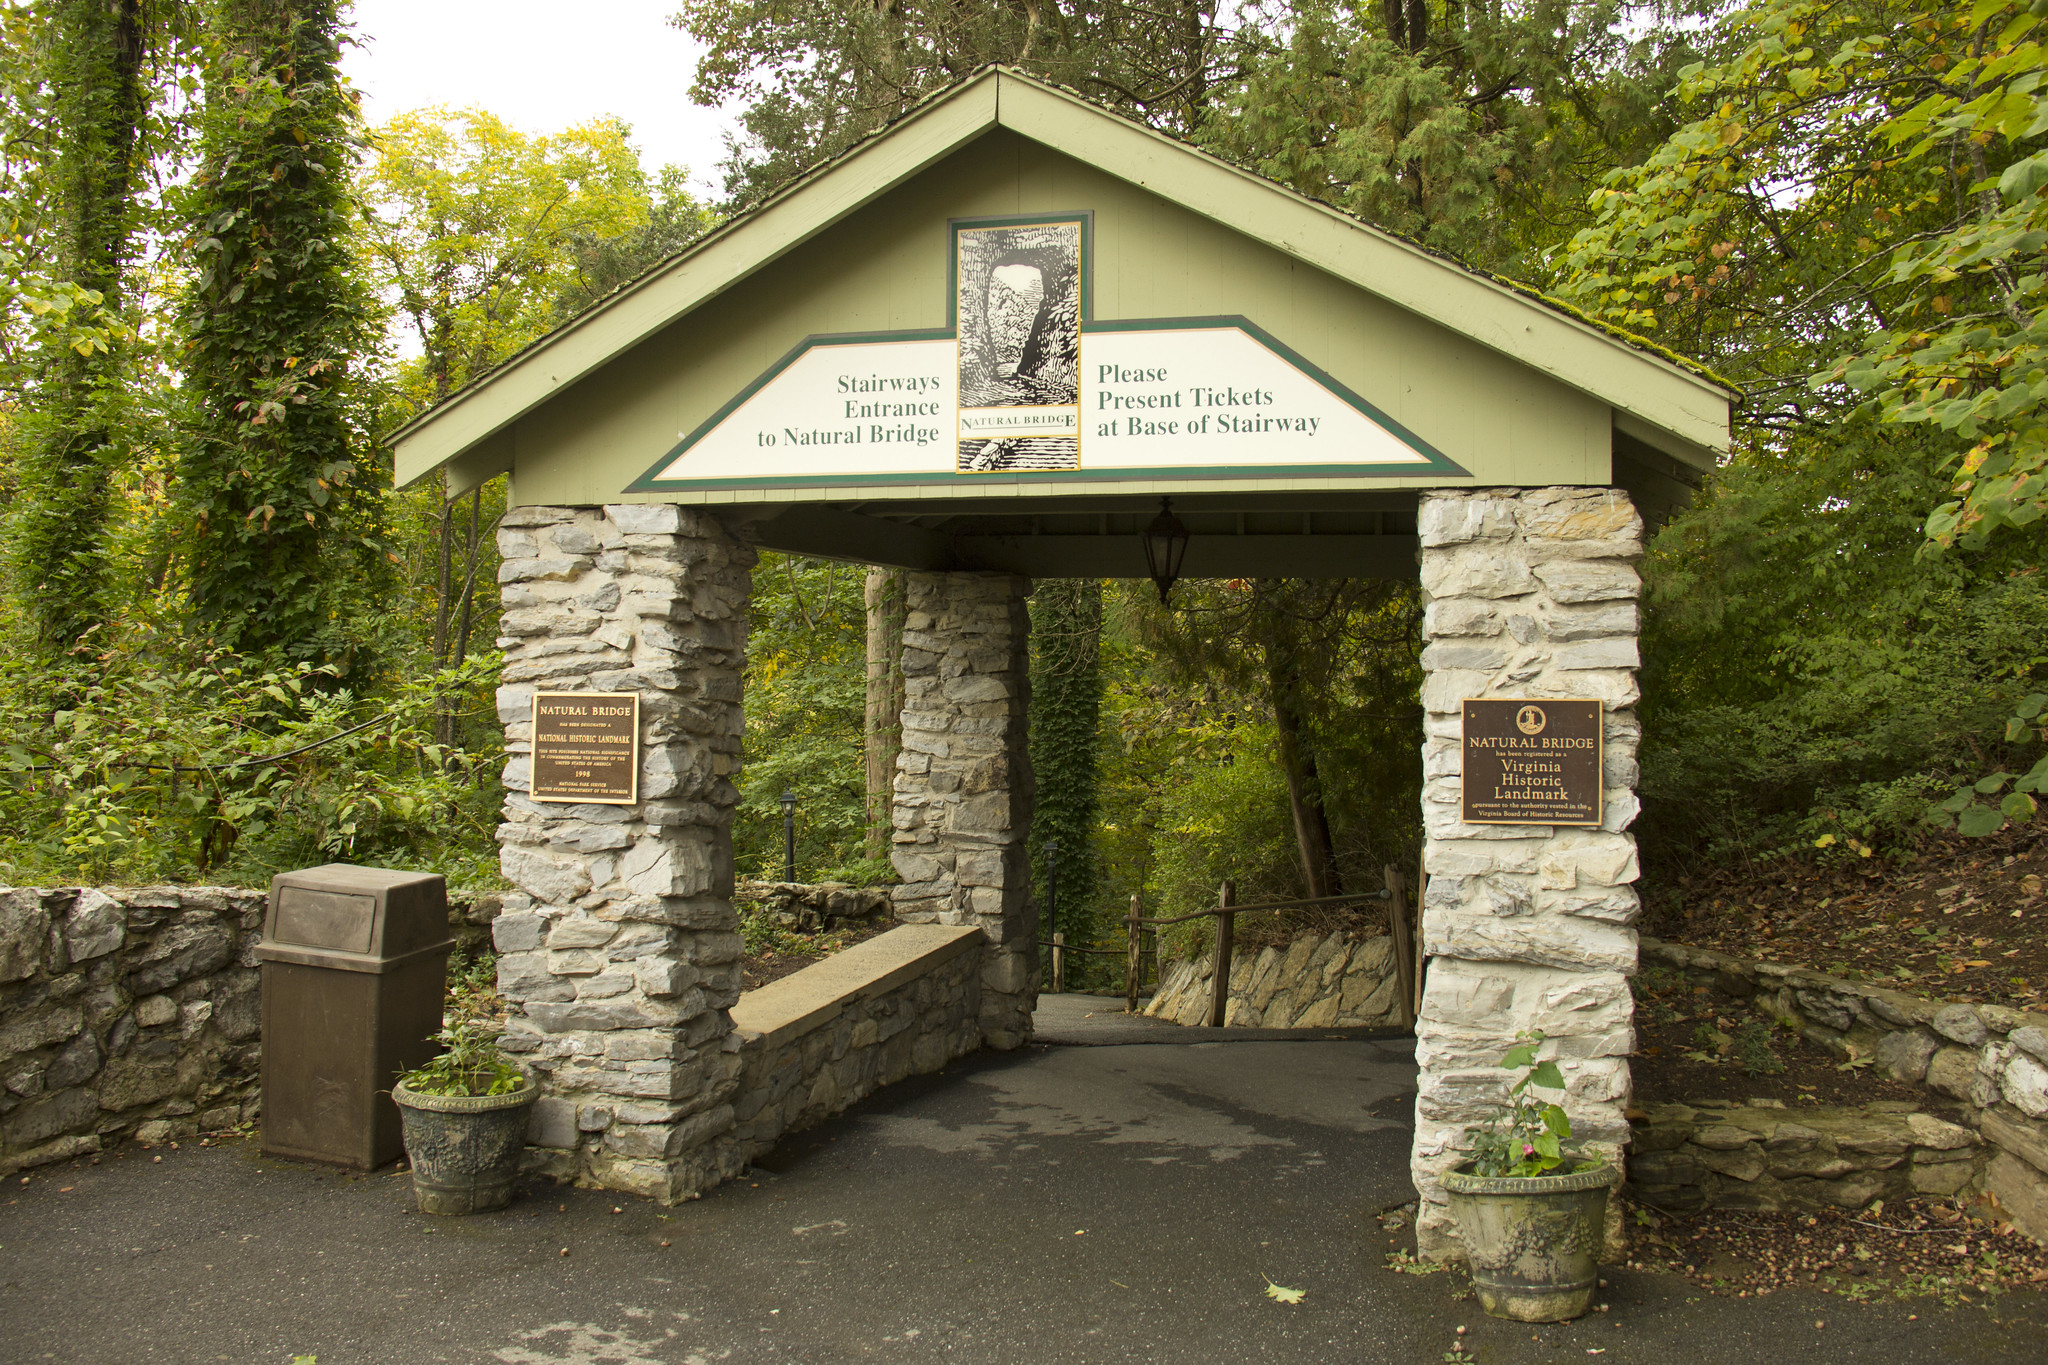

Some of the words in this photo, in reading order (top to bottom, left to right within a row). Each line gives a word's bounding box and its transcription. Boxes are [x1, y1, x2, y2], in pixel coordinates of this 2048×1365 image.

[1098, 364, 1168, 384] Please
[837, 374, 940, 395] Stairways
[1098, 391, 1182, 410] Present
[1190, 387, 1273, 408] Tickets
[845, 400, 940, 418] Entrance
[961, 416, 1021, 430] NATURAL
[1024, 414, 1076, 427] BRIDGE
[1098, 419, 1118, 437] at
[1128, 417, 1179, 436] Base
[1187, 415, 1209, 434] of
[1217, 413, 1321, 436] Stairway
[758, 430, 776, 447] to
[784, 426, 861, 446] Natural
[870, 424, 939, 446] Bridge
[540, 706, 587, 715] NATURAL
[592, 707, 630, 716] BRIDGE
[539, 734, 567, 743] NATIONAL
[569, 735, 596, 743] HISTORIC
[598, 736, 630, 744] LANDMARK
[1470, 737, 1538, 748] NATURAL
[1542, 738, 1594, 748] BRIDGE
[1501, 759, 1561, 774] Virginia
[1502, 774, 1561, 786] Historic
[1494, 787, 1568, 800] Landmark
